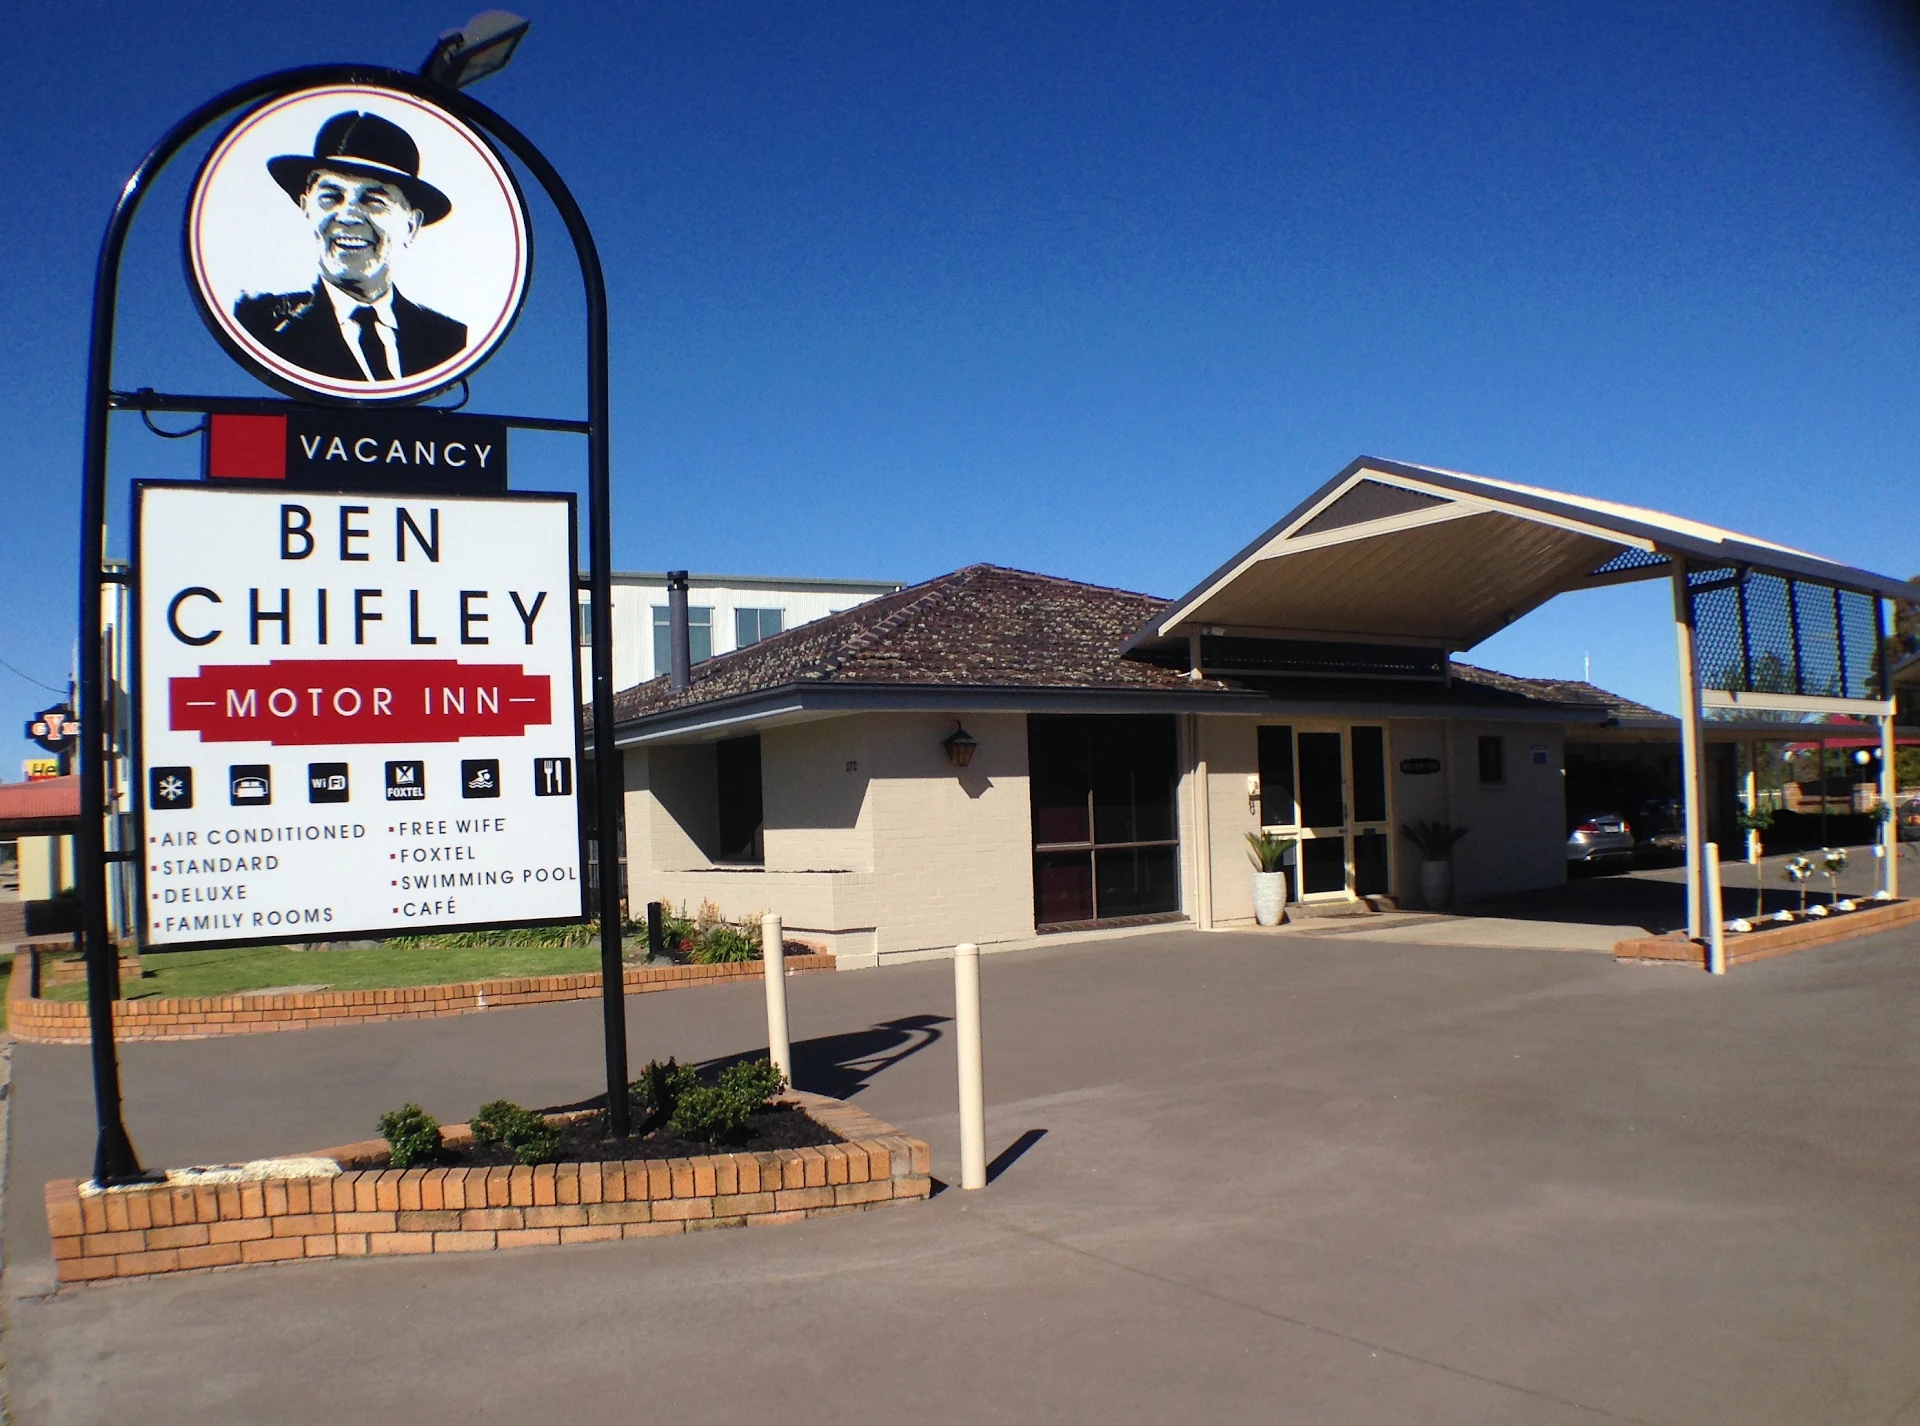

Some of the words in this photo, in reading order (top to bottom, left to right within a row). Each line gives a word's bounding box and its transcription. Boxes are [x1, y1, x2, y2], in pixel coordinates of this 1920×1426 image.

[299, 434, 493, 468] VACANCY
[280, 504, 440, 563] BEN
[166, 586, 548, 646] CHIFLEY
[226, 687, 394, 718] MOTOR
[424, 687, 500, 715] INN
[32, 714, 80, 740] GYM
[387, 787, 424, 798] FOXTEL
[161, 831, 198, 847] AIR
[207, 824, 366, 845] CONDITIONED
[399, 821, 447, 836] FREE
[456, 818, 506, 833] WIFE
[162, 855, 279, 875] STANDARD
[400, 846, 476, 863] FOXTEL
[402, 870, 515, 890] SWIMMING
[523, 867, 577, 883] POOL
[164, 885, 248, 904] DELUXE
[403, 896, 456, 917] CAFÉ
[165, 913, 244, 932] FAMILY
[253, 907, 334, 926] ROOMS
